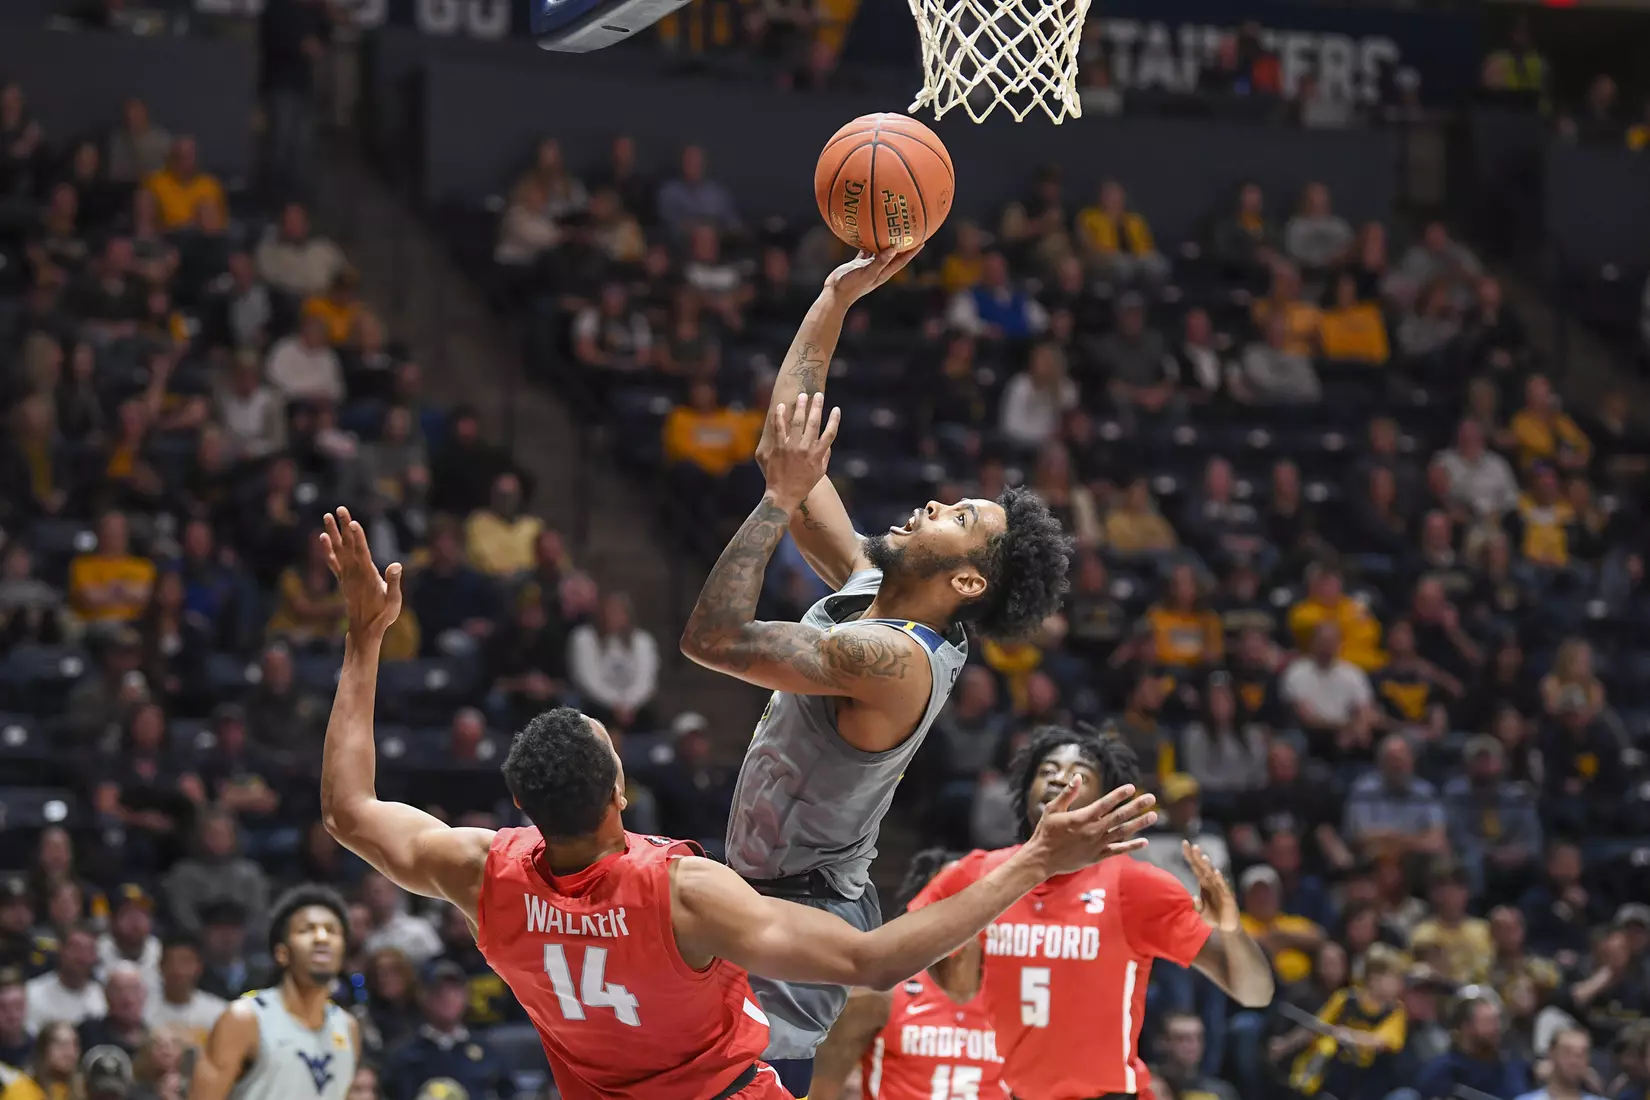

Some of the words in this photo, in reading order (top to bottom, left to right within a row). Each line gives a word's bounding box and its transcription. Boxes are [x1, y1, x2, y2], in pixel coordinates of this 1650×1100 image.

[882, 190, 902, 248] EGACY
[985, 923, 1100, 960] RADFORD
[544, 943, 641, 1026] 14
[1021, 966, 1050, 1028] 5
[930, 1064, 983, 1100] 15
